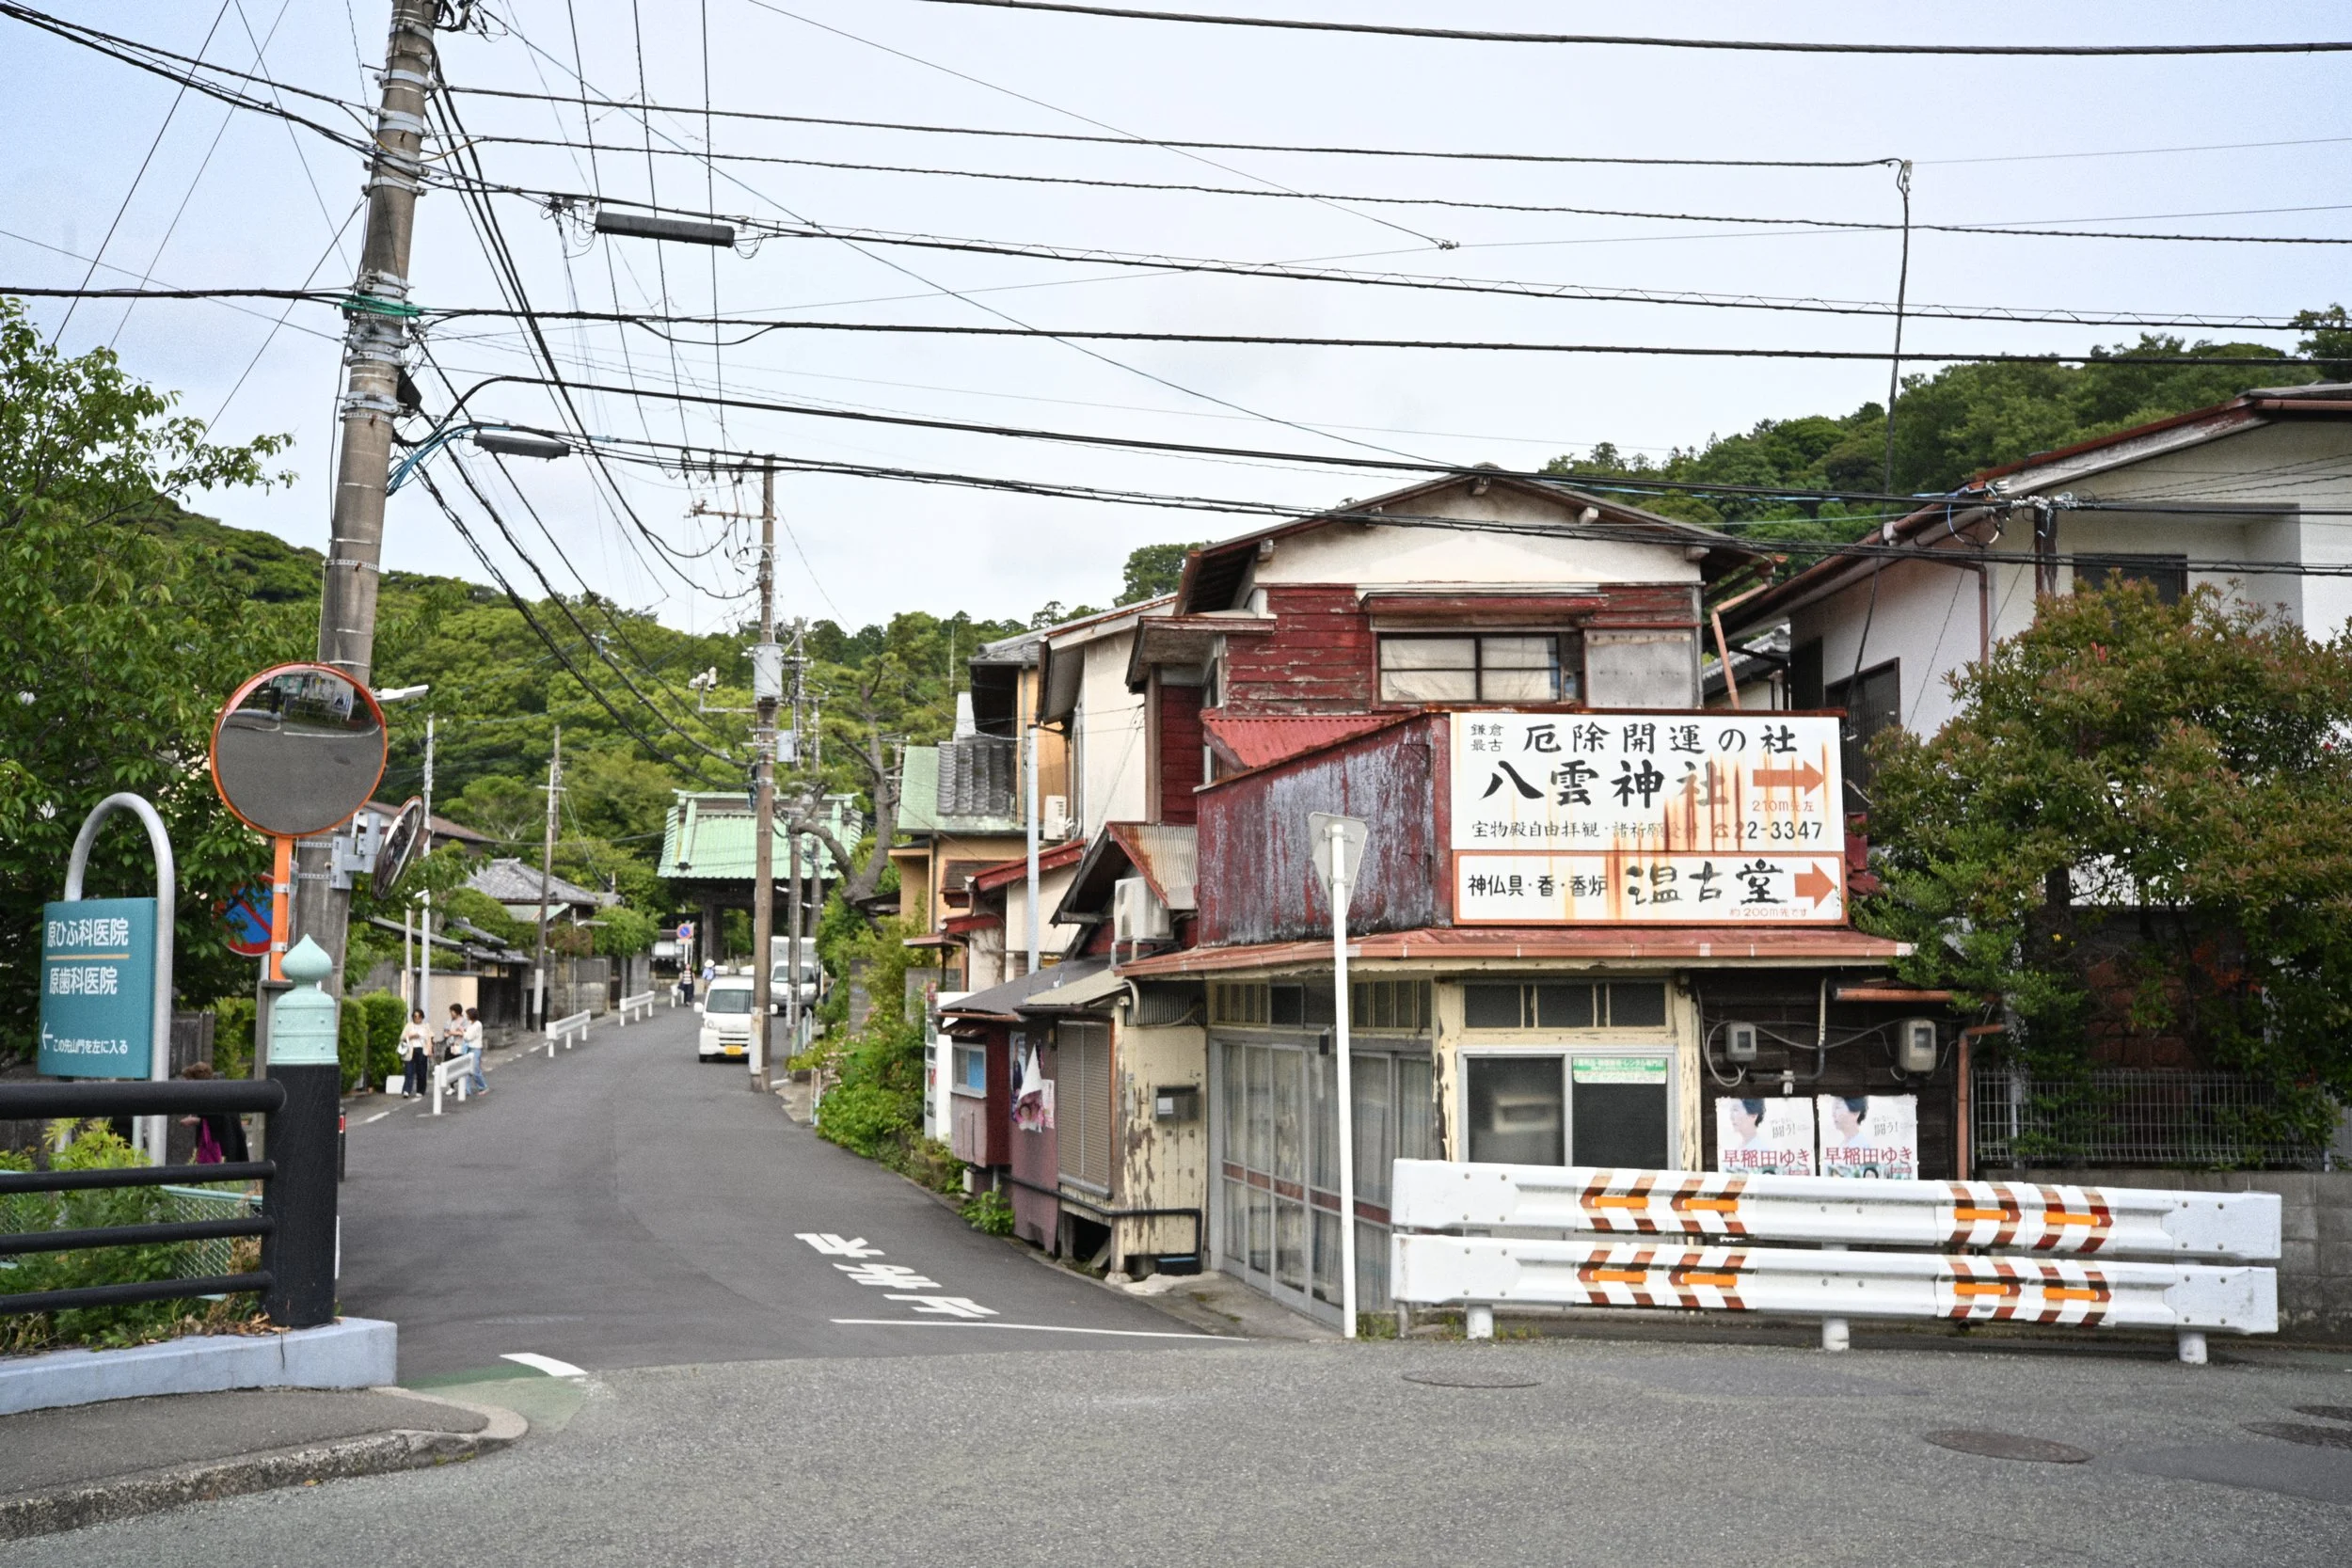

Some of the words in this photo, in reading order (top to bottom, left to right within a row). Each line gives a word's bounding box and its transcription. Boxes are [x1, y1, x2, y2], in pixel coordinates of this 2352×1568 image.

[1471, 723, 1503, 736] 鎌倉
[1523, 721, 1798, 754] 厄除開運の社
[1471, 739, 1503, 752] 最古
[1479, 759, 1729, 809] 八雲神社
[1626, 858, 1788, 905] 温古堂
[47, 917, 129, 948] 原ひふ科医院
[49, 965, 118, 995] 原歯科医院
[54, 1038, 128, 1054] この先山門を左に入る
[1722, 1148, 1810, 1168] 早稲田ゆき
[1825, 1146, 1913, 1166] 早稲田ゆき
